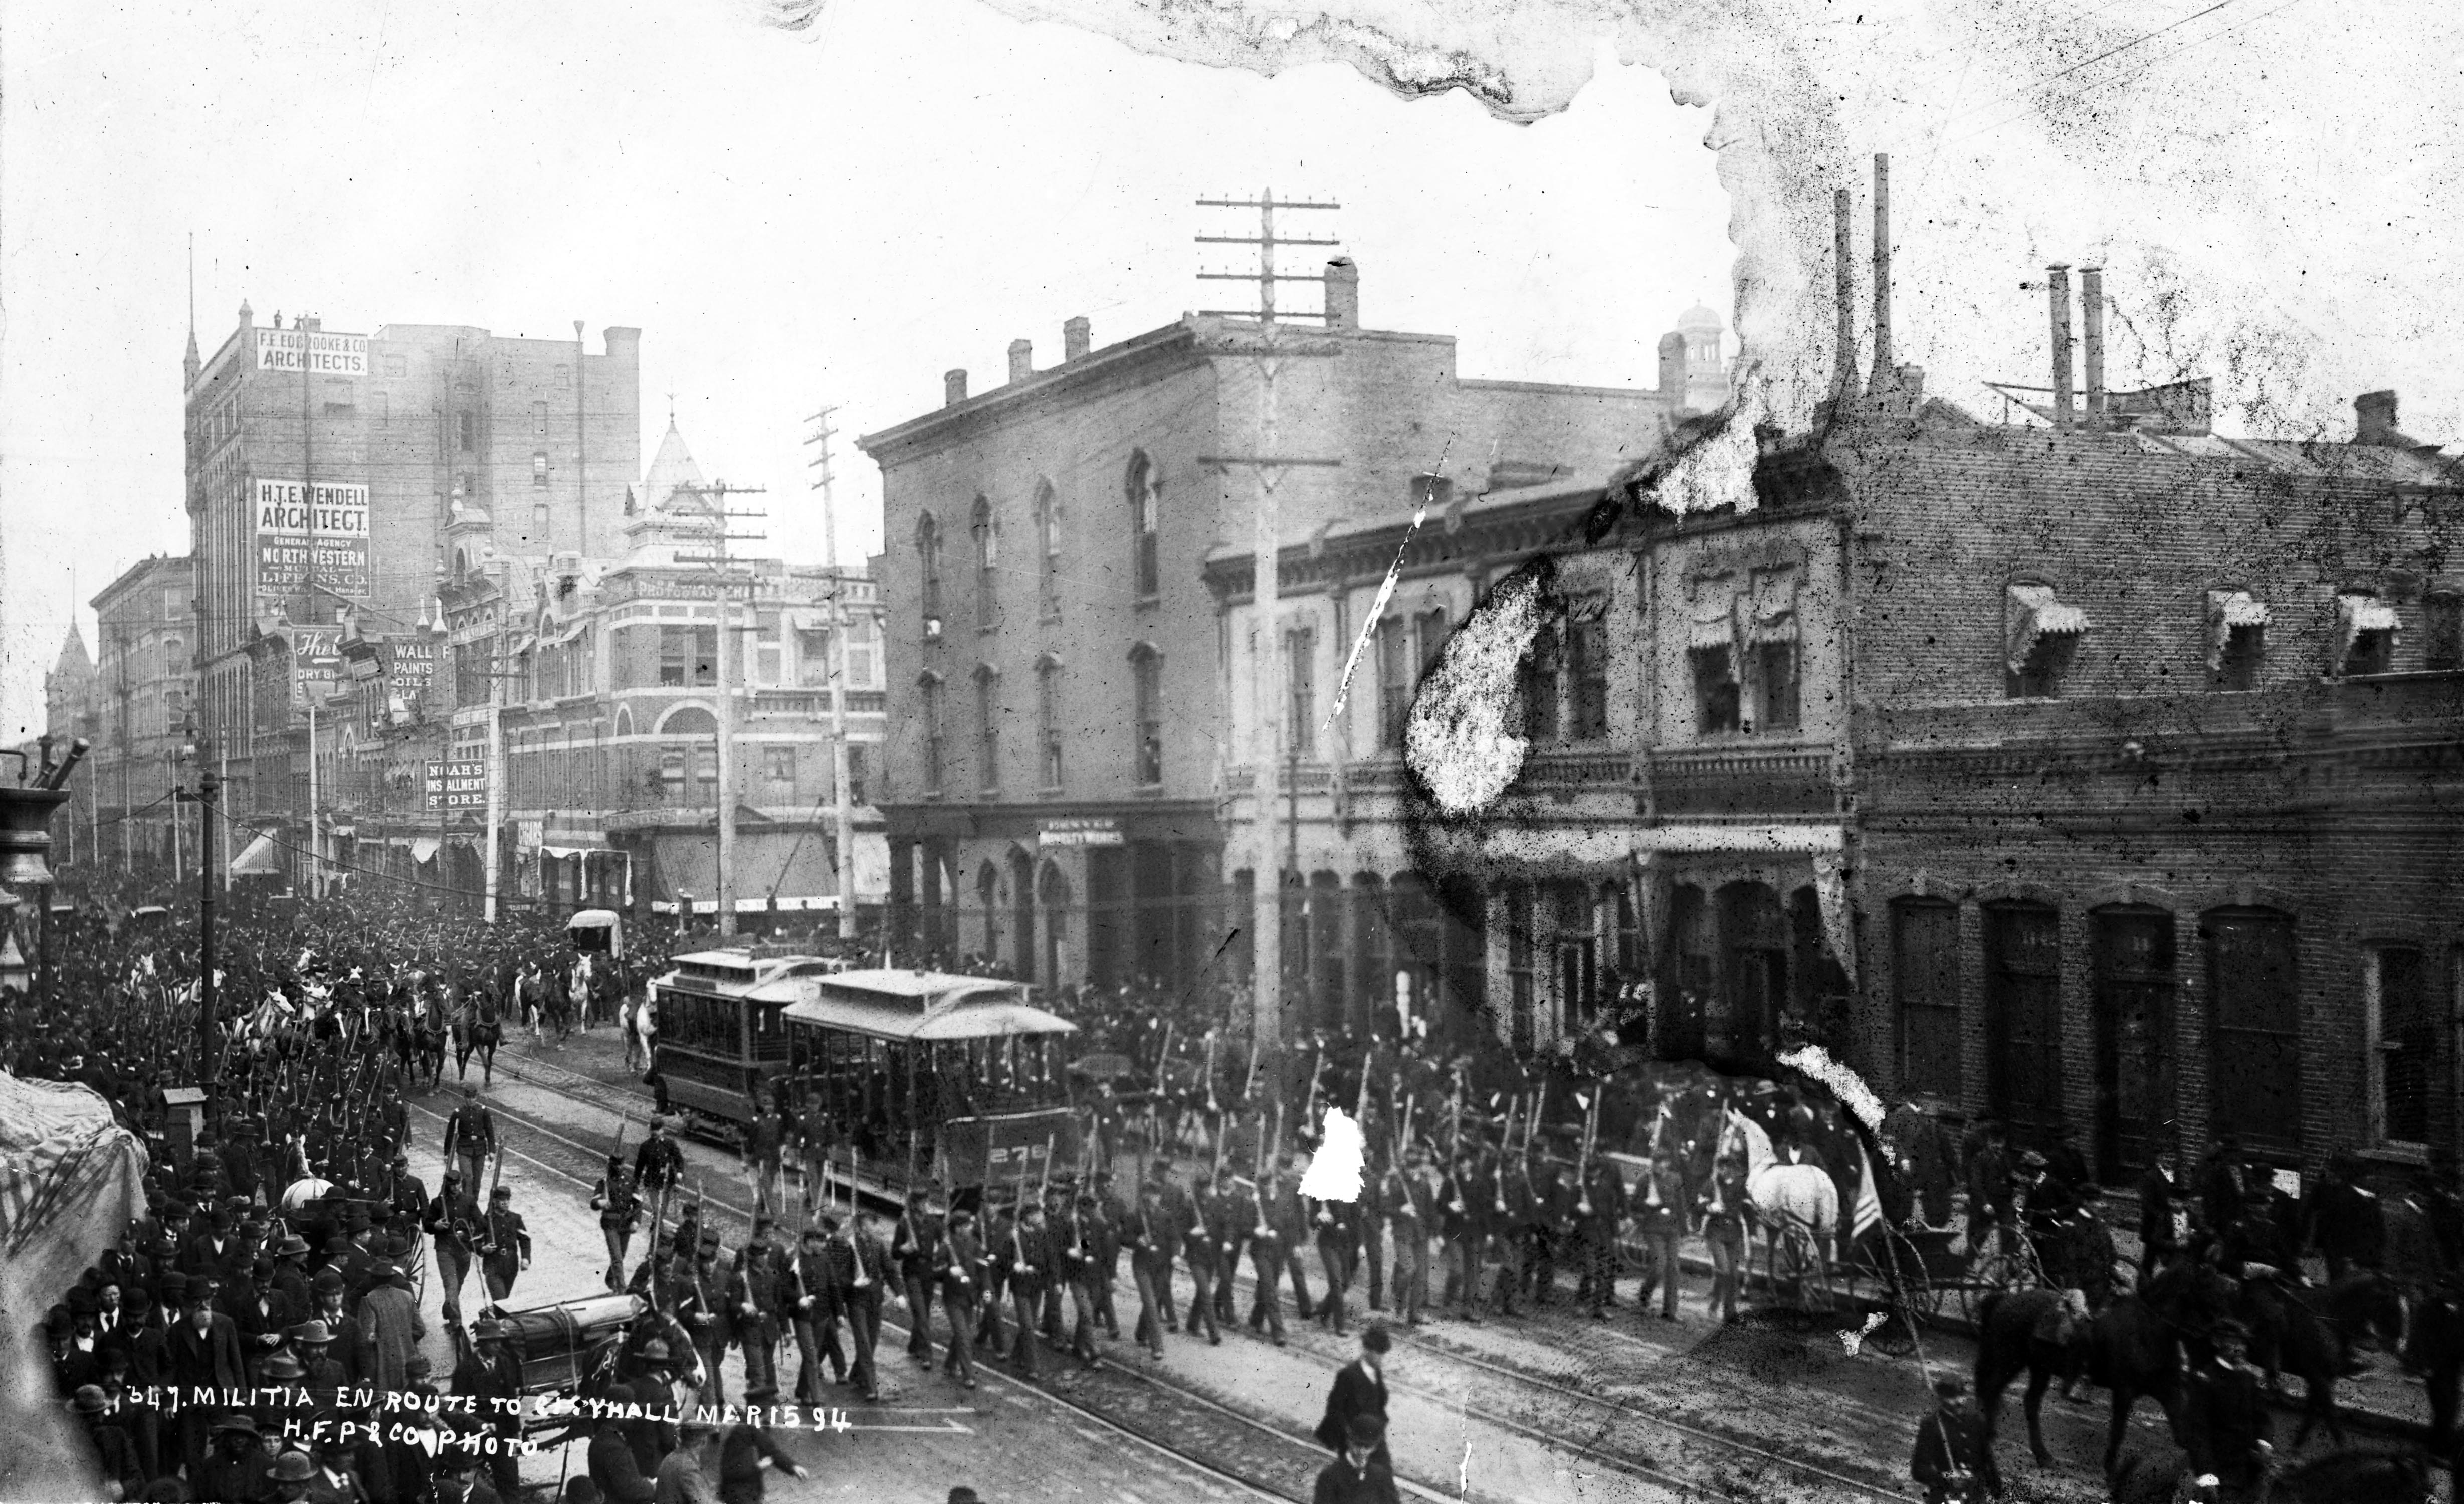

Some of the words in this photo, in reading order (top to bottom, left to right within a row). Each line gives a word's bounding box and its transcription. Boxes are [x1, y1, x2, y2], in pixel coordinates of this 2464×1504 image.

[343, 338, 350, 351] &
[262, 507, 367, 531] ARCHITECT.
[317, 538, 352, 547] AGENCY
[315, 573, 341, 584] NS.
[335, 586, 367, 595] Manaer.
[395, 645, 432, 659] WALL
[298, 669, 320, 679] DRY
[394, 662, 433, 674] PAINTS
[427, 778, 484, 792] INSALLMENT
